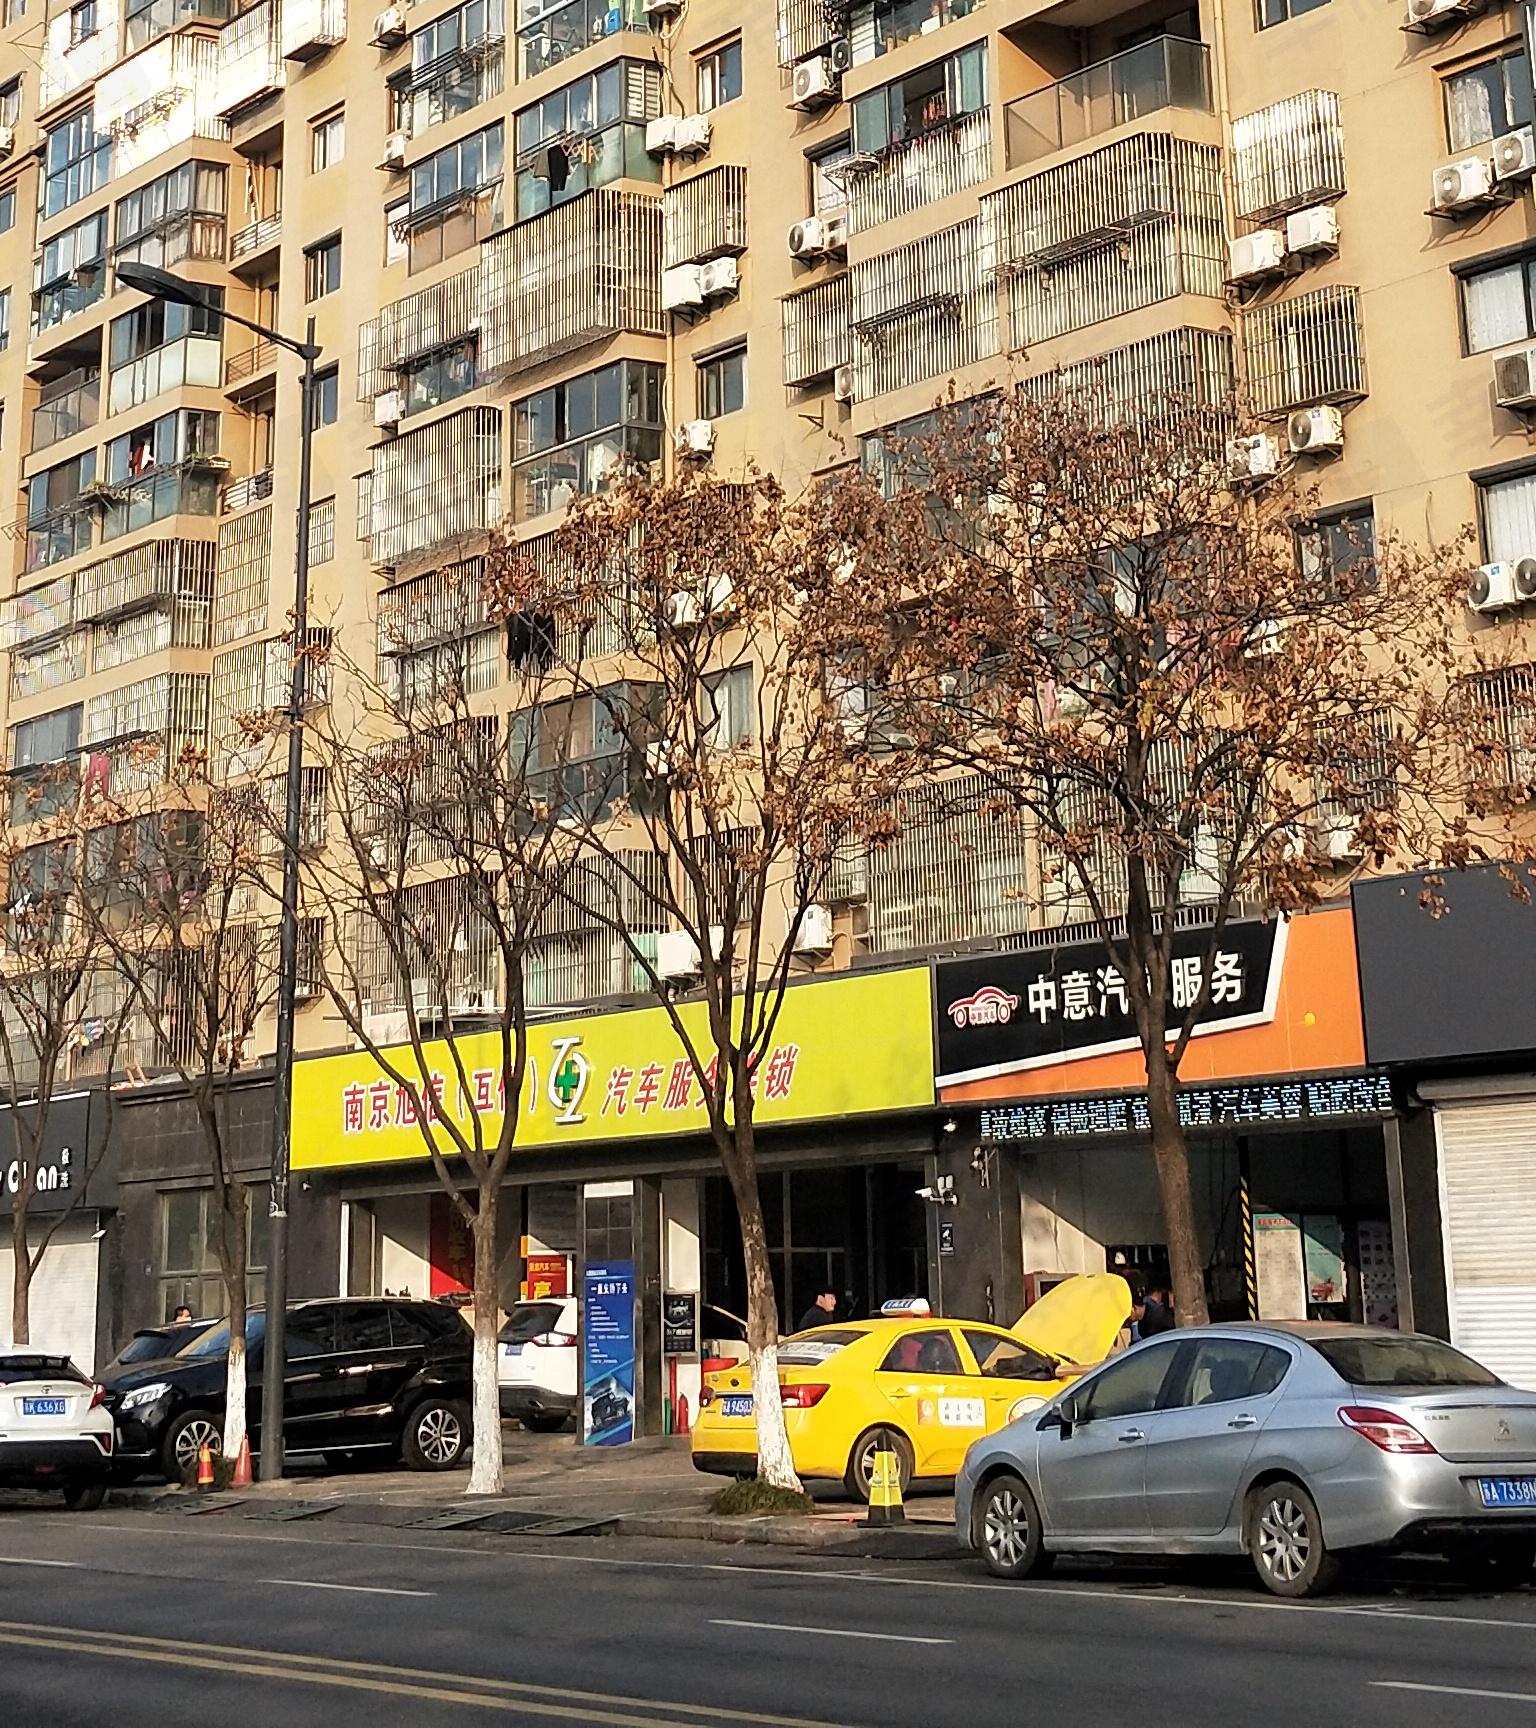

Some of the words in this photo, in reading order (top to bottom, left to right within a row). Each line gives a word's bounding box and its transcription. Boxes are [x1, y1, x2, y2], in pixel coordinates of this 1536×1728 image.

[1027, 951, 1244, 1024] 中意汽服务
[8, 1160, 58, 1193] Clan
